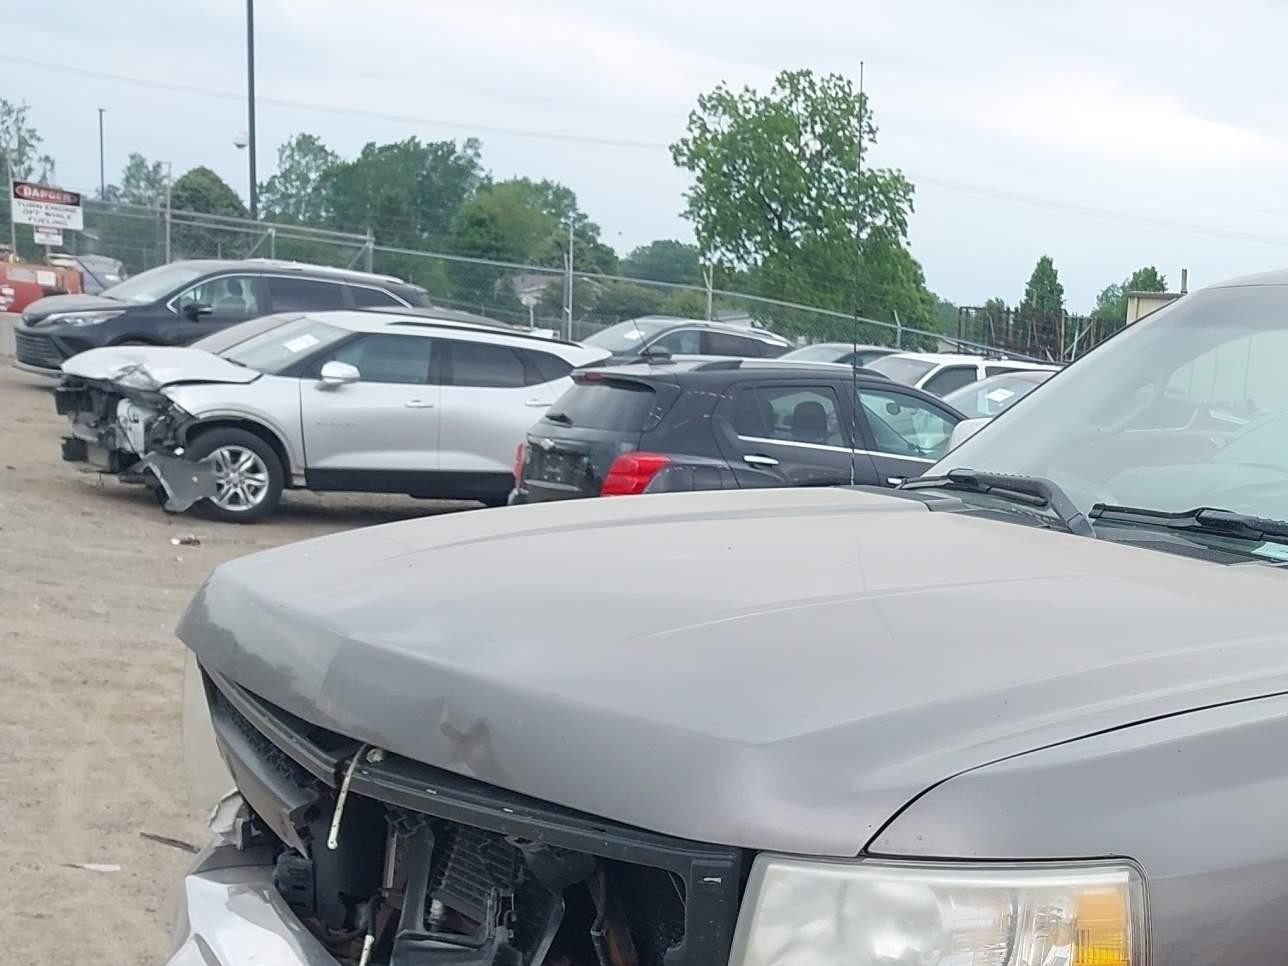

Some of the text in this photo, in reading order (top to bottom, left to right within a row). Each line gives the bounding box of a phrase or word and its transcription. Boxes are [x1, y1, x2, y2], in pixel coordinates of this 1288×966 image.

[23, 186, 72, 203] DANGER
[17, 202, 77, 213] TURN ENGINE
[44, 211, 72, 220] WHILE
[28, 217, 69, 226] FUELING
